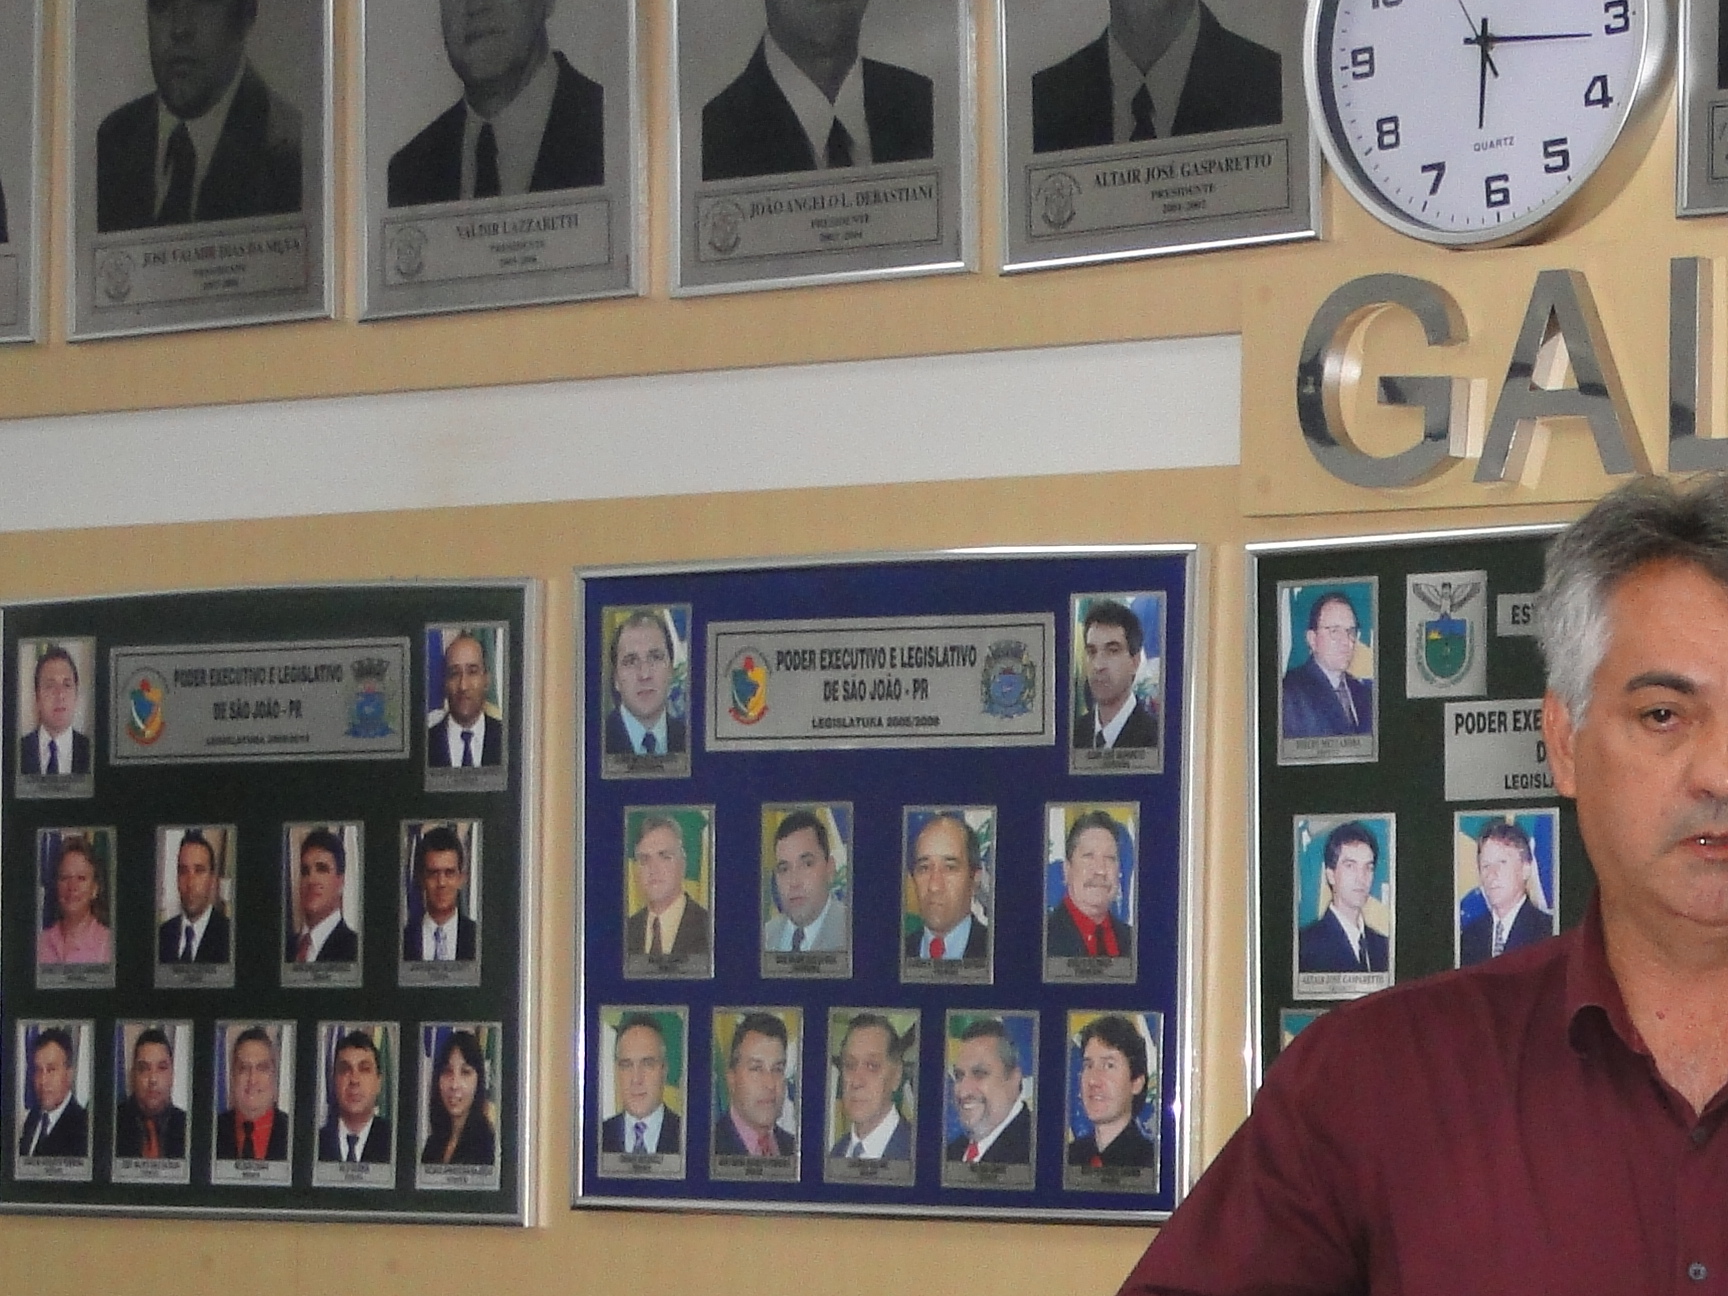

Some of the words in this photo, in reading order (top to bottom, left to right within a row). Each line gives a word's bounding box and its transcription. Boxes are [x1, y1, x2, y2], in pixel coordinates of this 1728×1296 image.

[1604, 0, 1629, 35] 3
[1351, 46, 1374, 81] 9
[1584, 74, 1613, 110] 4
[1376, 115, 1400, 151] 8
[1473, 136, 1515, 153] QUARTZ
[1093, 168, 1142, 189] ALTAIR
[1180, 153, 1274, 180] GASPARETTO
[1543, 137, 1570, 175] 5
[1421, 161, 1446, 196] 7
[1485, 174, 1510, 209] 6
[1511, 603, 1535, 625] ES
[776, 649, 816, 672] PODER
[820, 647, 888, 671] EXECUTIVO
[890, 646, 898, 669] E
[901, 644, 978, 669] LEGISLATIVO
[823, 680, 840, 702] DE
[869, 673, 903, 702] JOÃO
[912, 678, 929, 701] PR
[811, 717, 884, 729] LEGISLATURA
[1455, 710, 1508, 735] PODER
